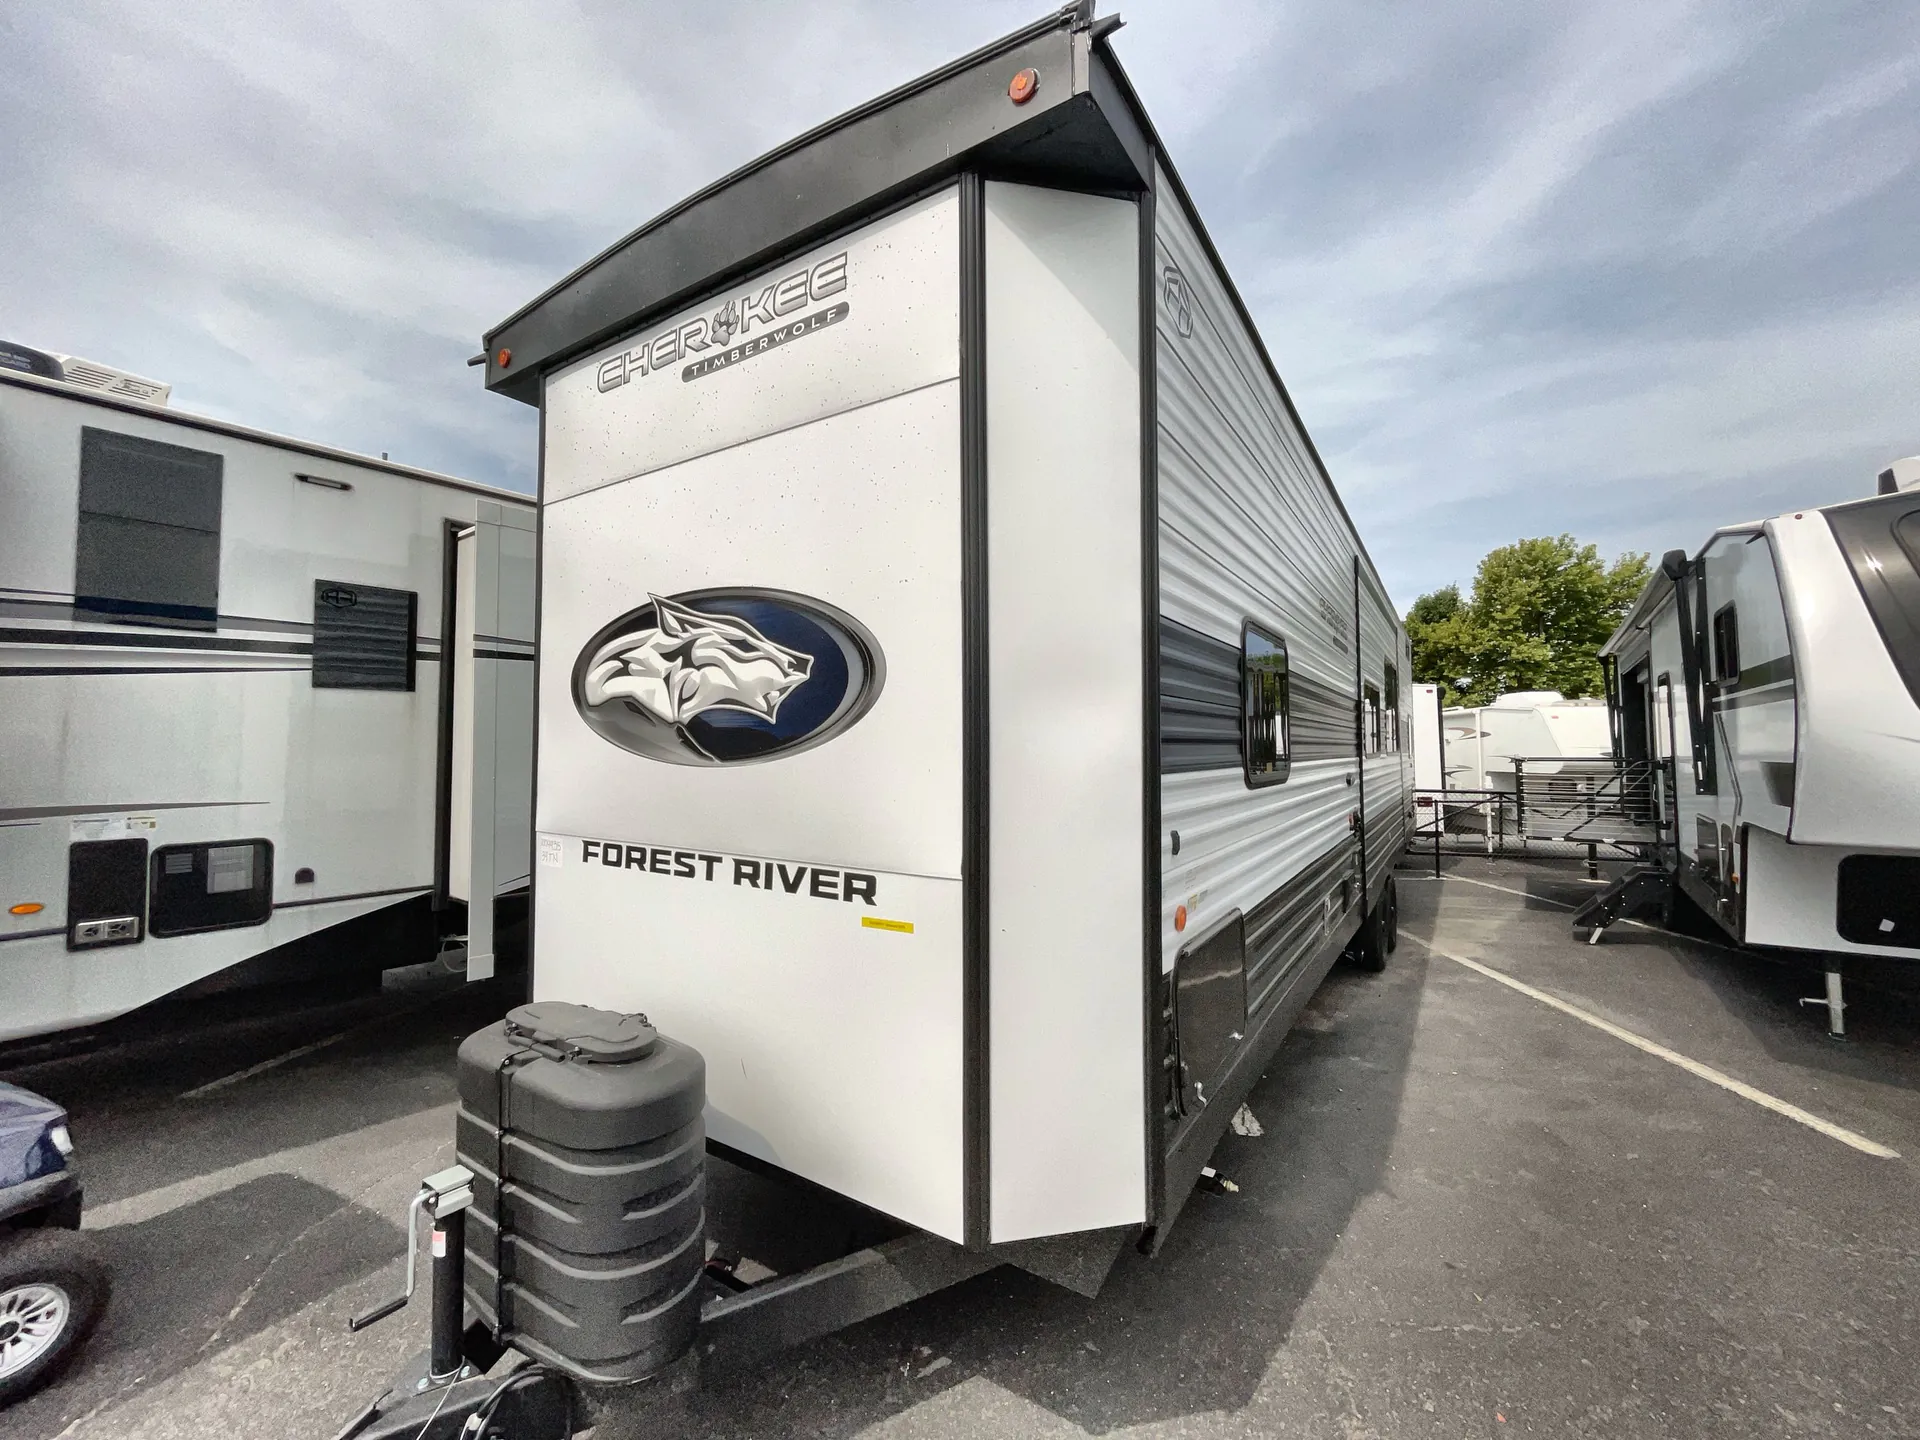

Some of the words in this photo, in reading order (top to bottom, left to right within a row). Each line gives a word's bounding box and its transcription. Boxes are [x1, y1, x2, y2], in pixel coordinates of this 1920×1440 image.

[691, 308, 838, 377] TIMBERWOLF
[581, 839, 723, 881] FOREST
[731, 857, 878, 906] RIVER
